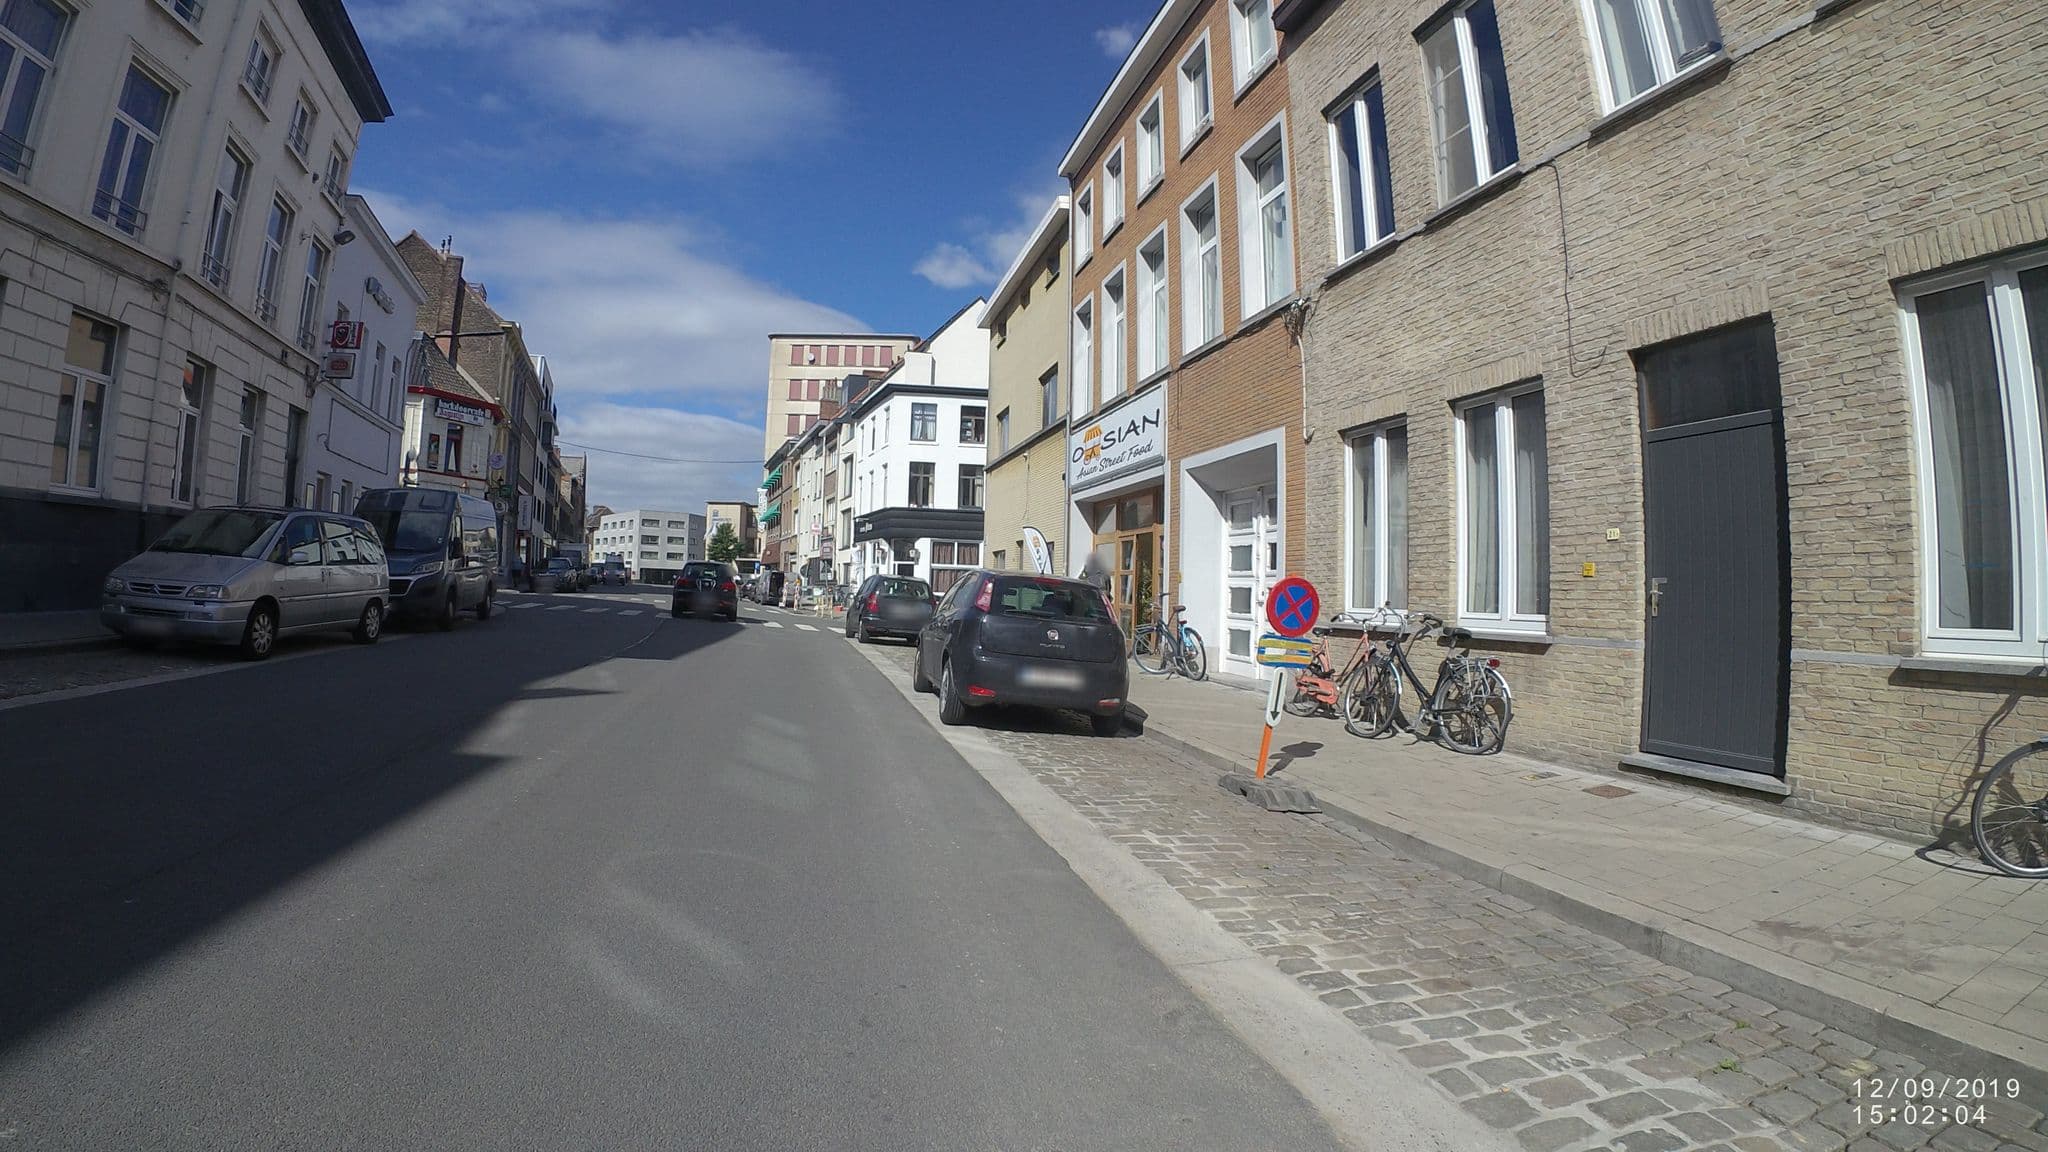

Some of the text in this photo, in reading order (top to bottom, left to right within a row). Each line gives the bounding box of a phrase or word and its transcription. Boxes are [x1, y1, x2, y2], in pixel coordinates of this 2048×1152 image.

[1076, 439, 1154, 480] Asian Street Food
